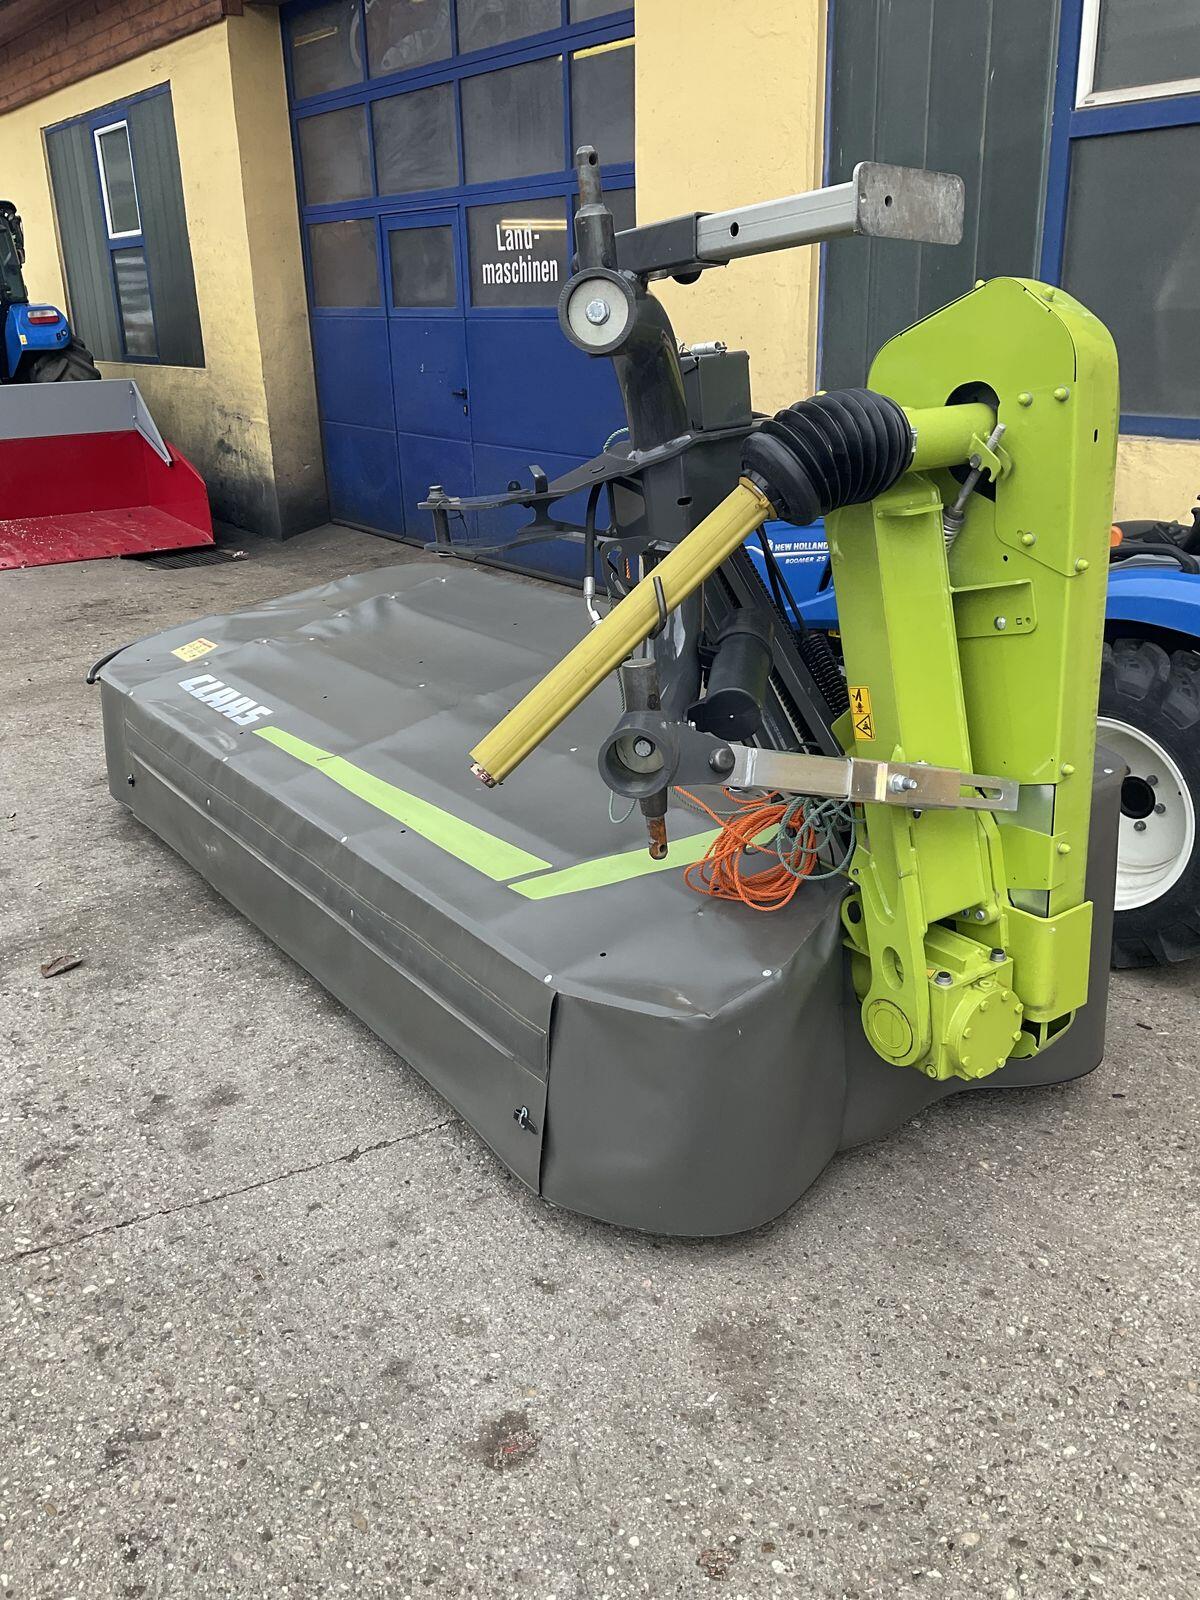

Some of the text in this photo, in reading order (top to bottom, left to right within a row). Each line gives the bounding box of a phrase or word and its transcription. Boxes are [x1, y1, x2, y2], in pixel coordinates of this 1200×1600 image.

[496, 223, 540, 251] Land-
[482, 255, 558, 284] maschinen
[774, 541, 829, 551] NEW HOLLAND
[785, 556, 815, 564] BOOMER
[177, 673, 275, 726] CLAAS
